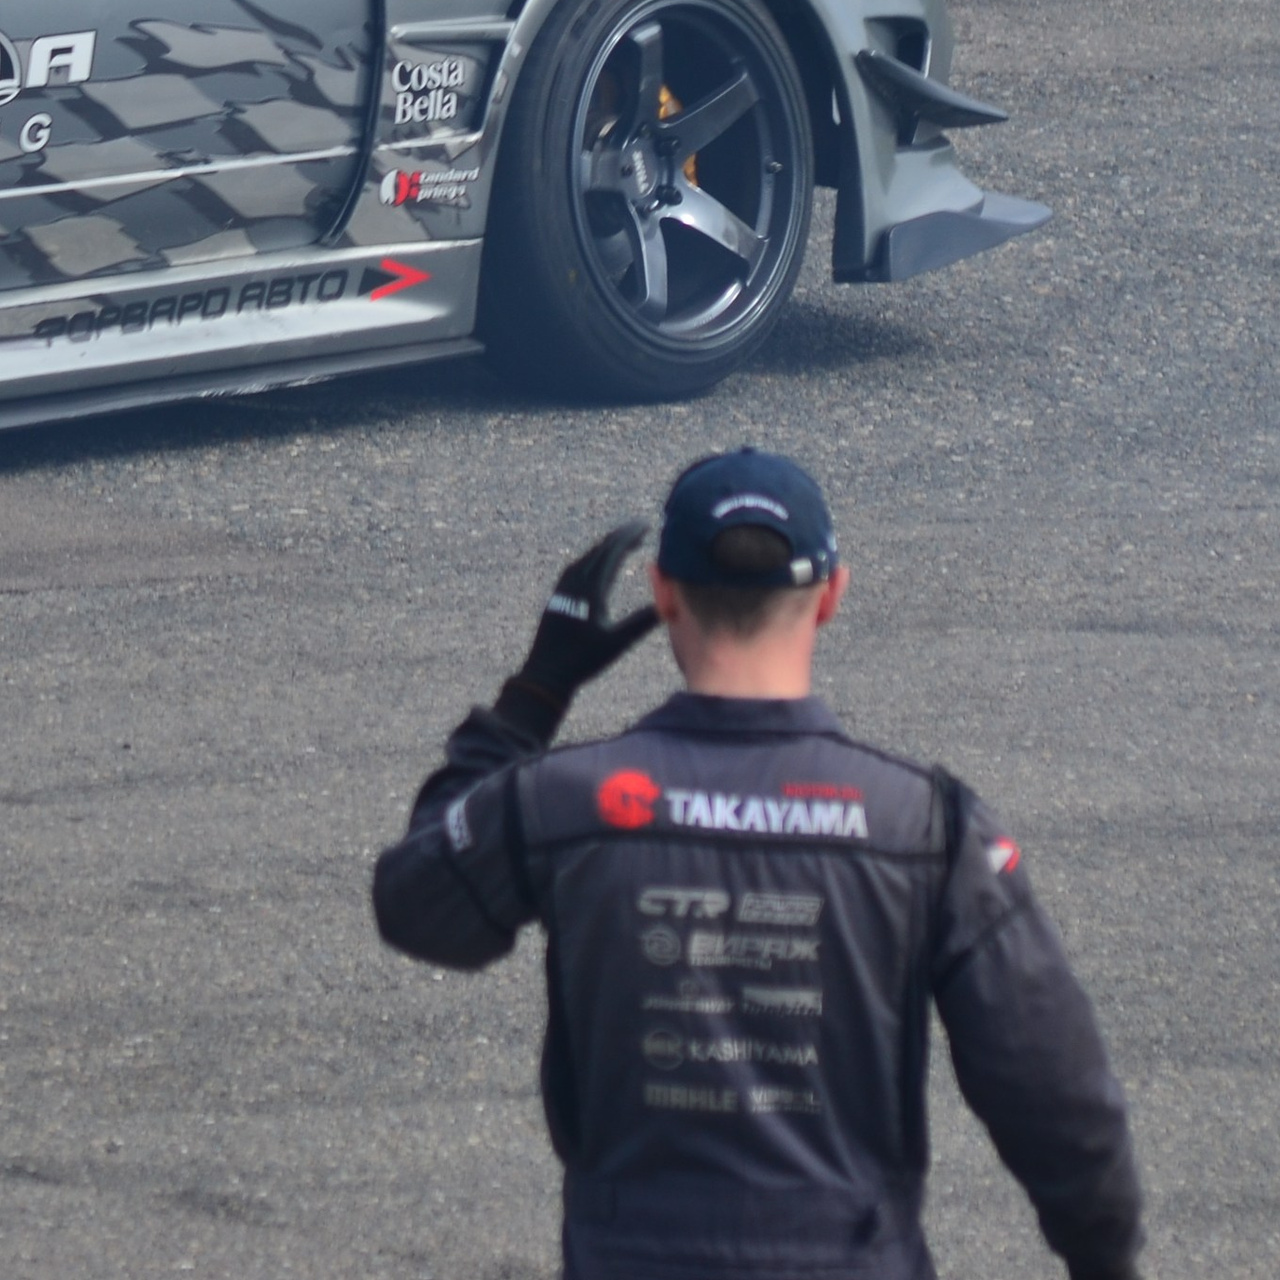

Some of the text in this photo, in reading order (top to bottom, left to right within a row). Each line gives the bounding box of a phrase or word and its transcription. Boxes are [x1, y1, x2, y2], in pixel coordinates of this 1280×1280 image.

[391, 57, 466, 93] Costa
[394, 88, 458, 125] Bella
[665, 786, 869, 840] TAKAYAMA
